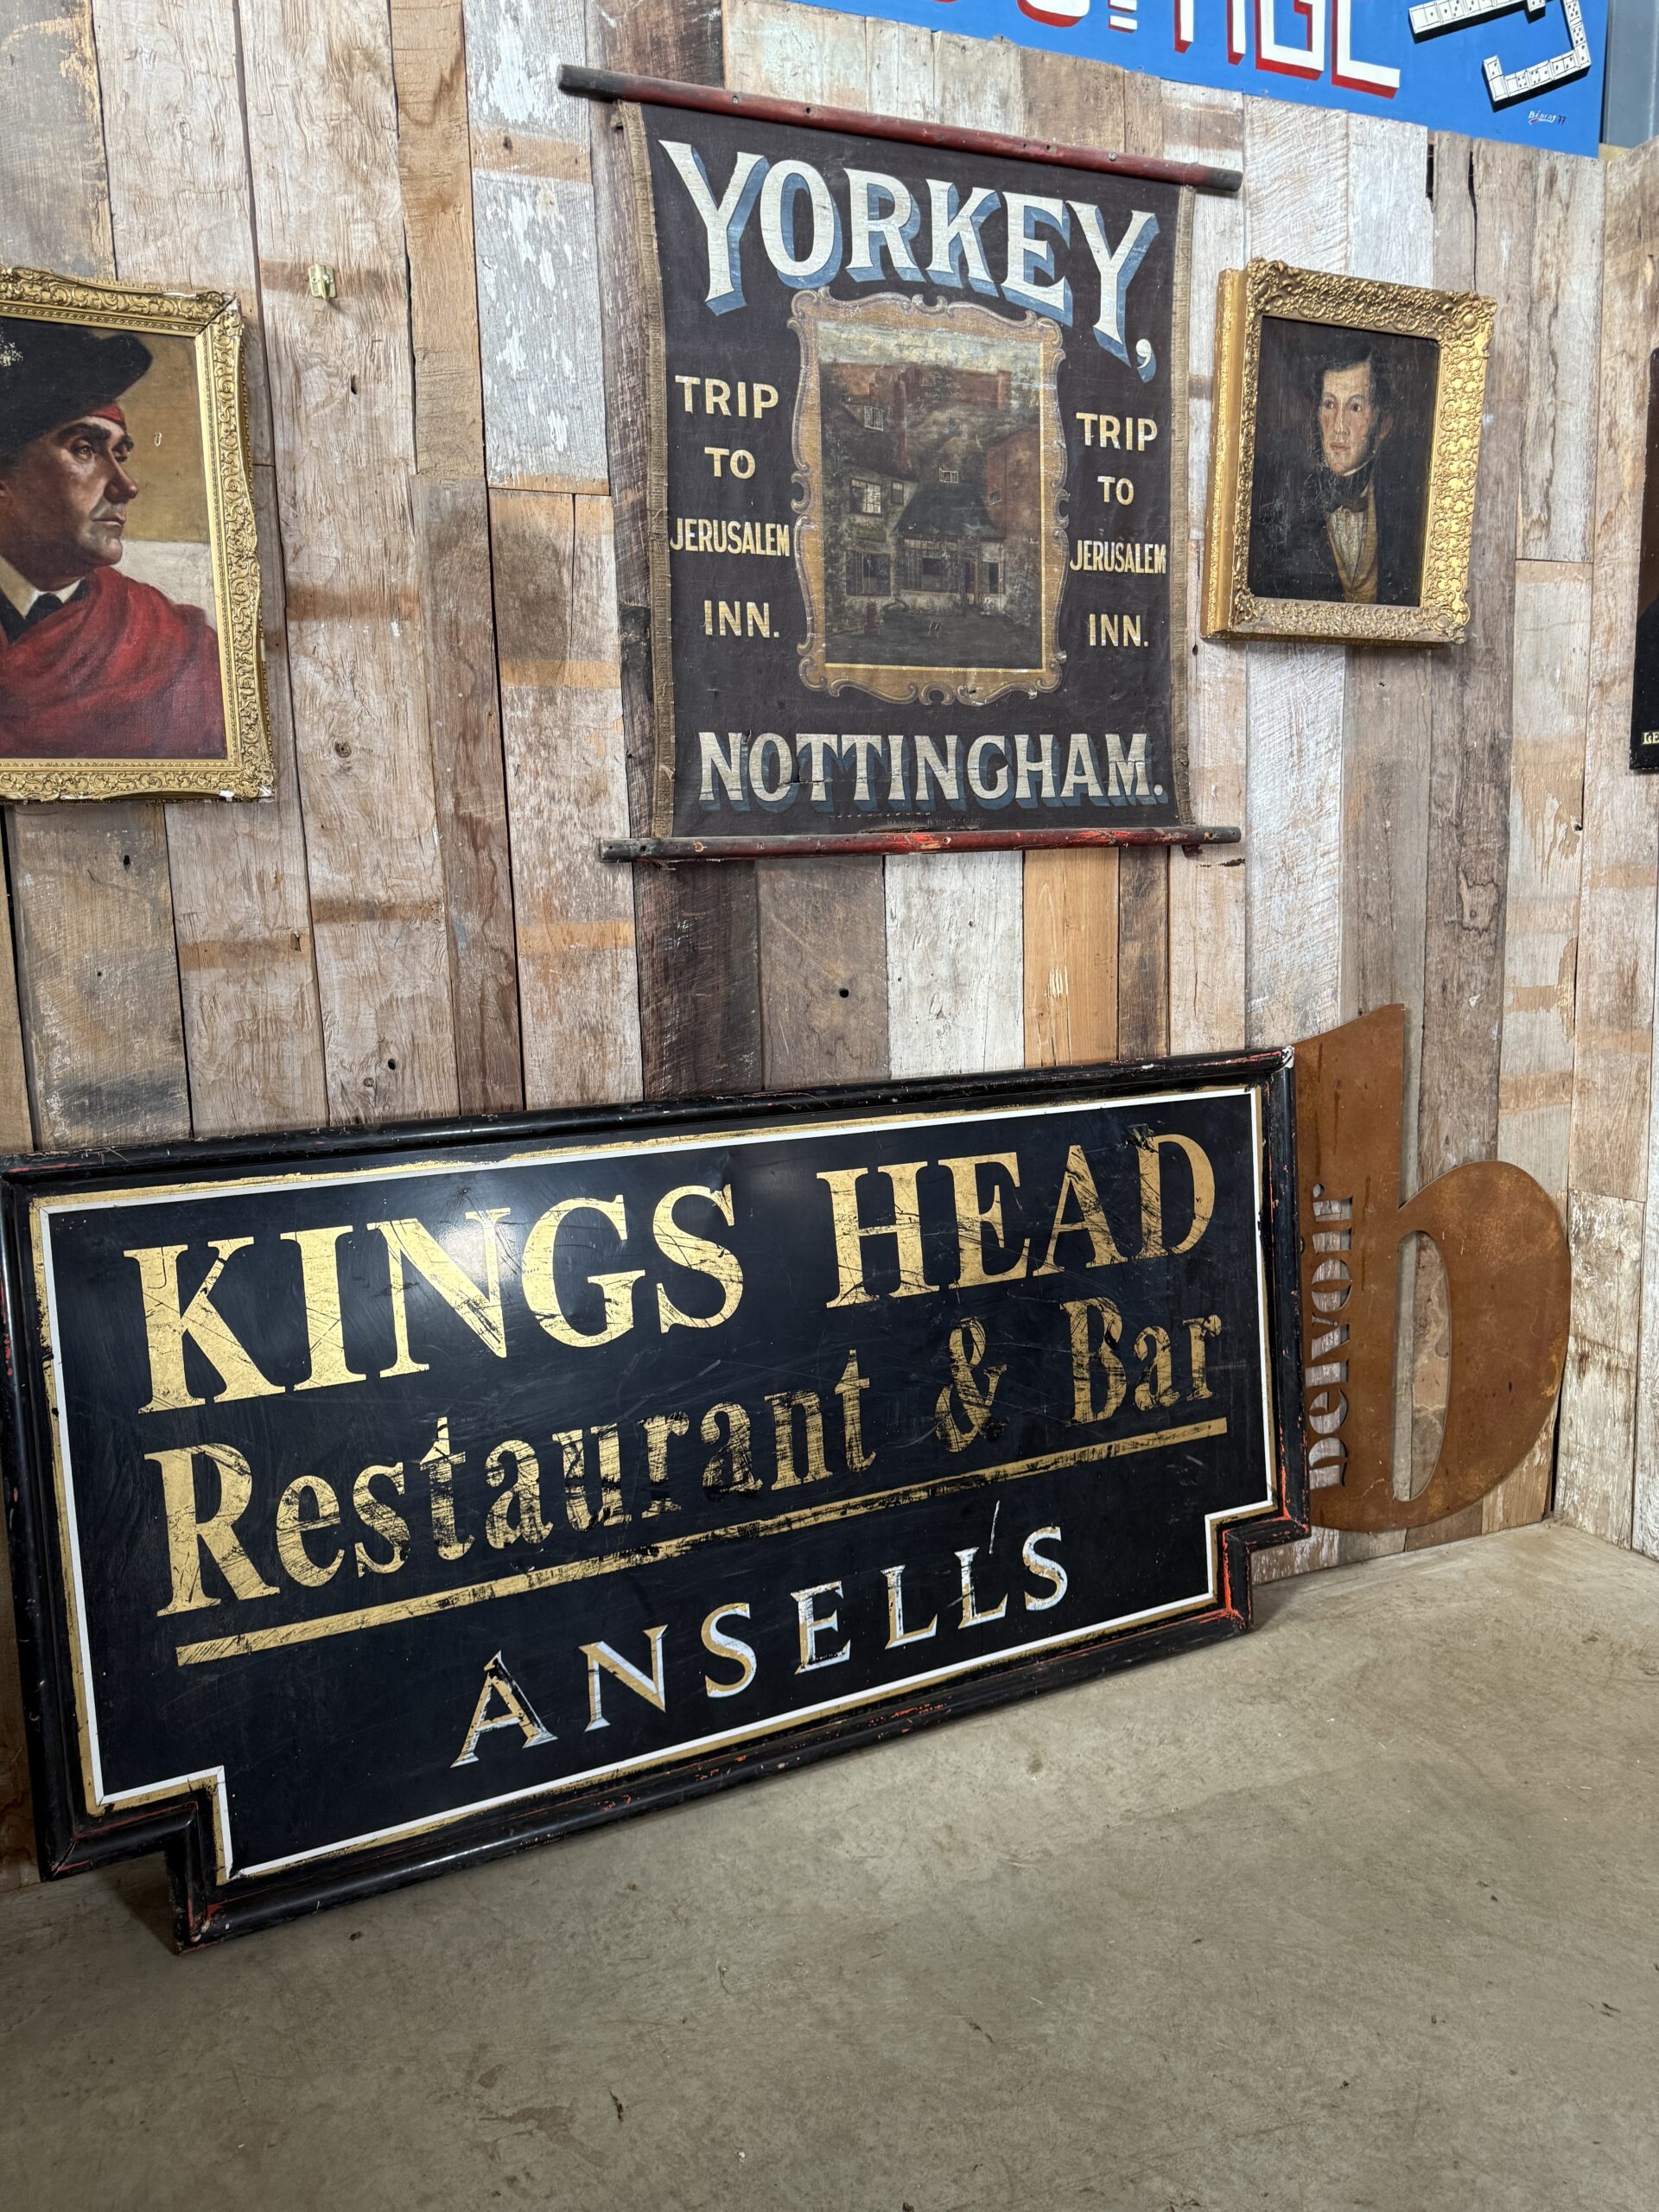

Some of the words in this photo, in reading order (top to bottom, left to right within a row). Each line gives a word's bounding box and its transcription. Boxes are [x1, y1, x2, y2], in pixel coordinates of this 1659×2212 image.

[658, 139, 1160, 384] YORKEY,
[675, 375, 779, 418] TRIP
[1076, 412, 1158, 451] TRIP
[704, 447, 756, 480] TO
[1097, 476, 1135, 505] TO
[670, 518, 790, 557] JERUSALEM
[1070, 540, 1166, 574] JERUSALEM
[703, 600, 779, 638] INN.
[1089, 613, 1149, 647] INN.
[697, 731, 1169, 813] NOTTINGHAM.
[123, 1184, 745, 1414] KINGS
[817, 1132, 1216, 1309] HEAD
[143, 1348, 876, 1617] Restaurant
[934, 1316, 1008, 1453] &
[1060, 1296, 1222, 1426] Bar
[449, 1525, 1070, 1769] ANSELLS
